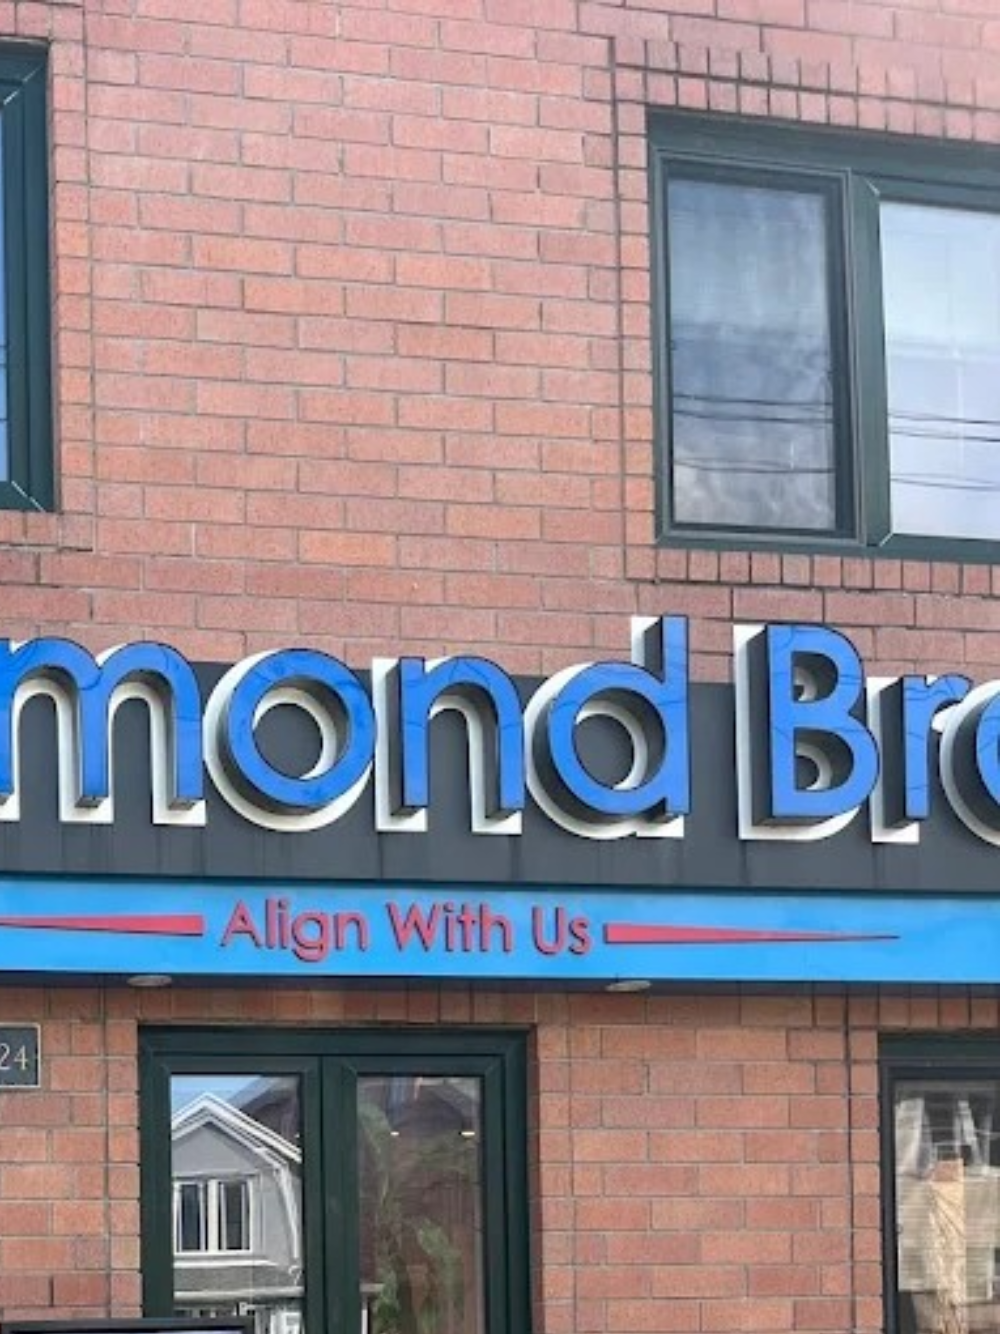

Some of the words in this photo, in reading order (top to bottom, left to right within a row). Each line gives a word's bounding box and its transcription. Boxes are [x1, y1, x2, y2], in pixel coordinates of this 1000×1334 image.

[733, 622, 1000, 846] Br
[220, 898, 368, 962] Align
[386, 902, 514, 953] With
[532, 905, 592, 955] Us
